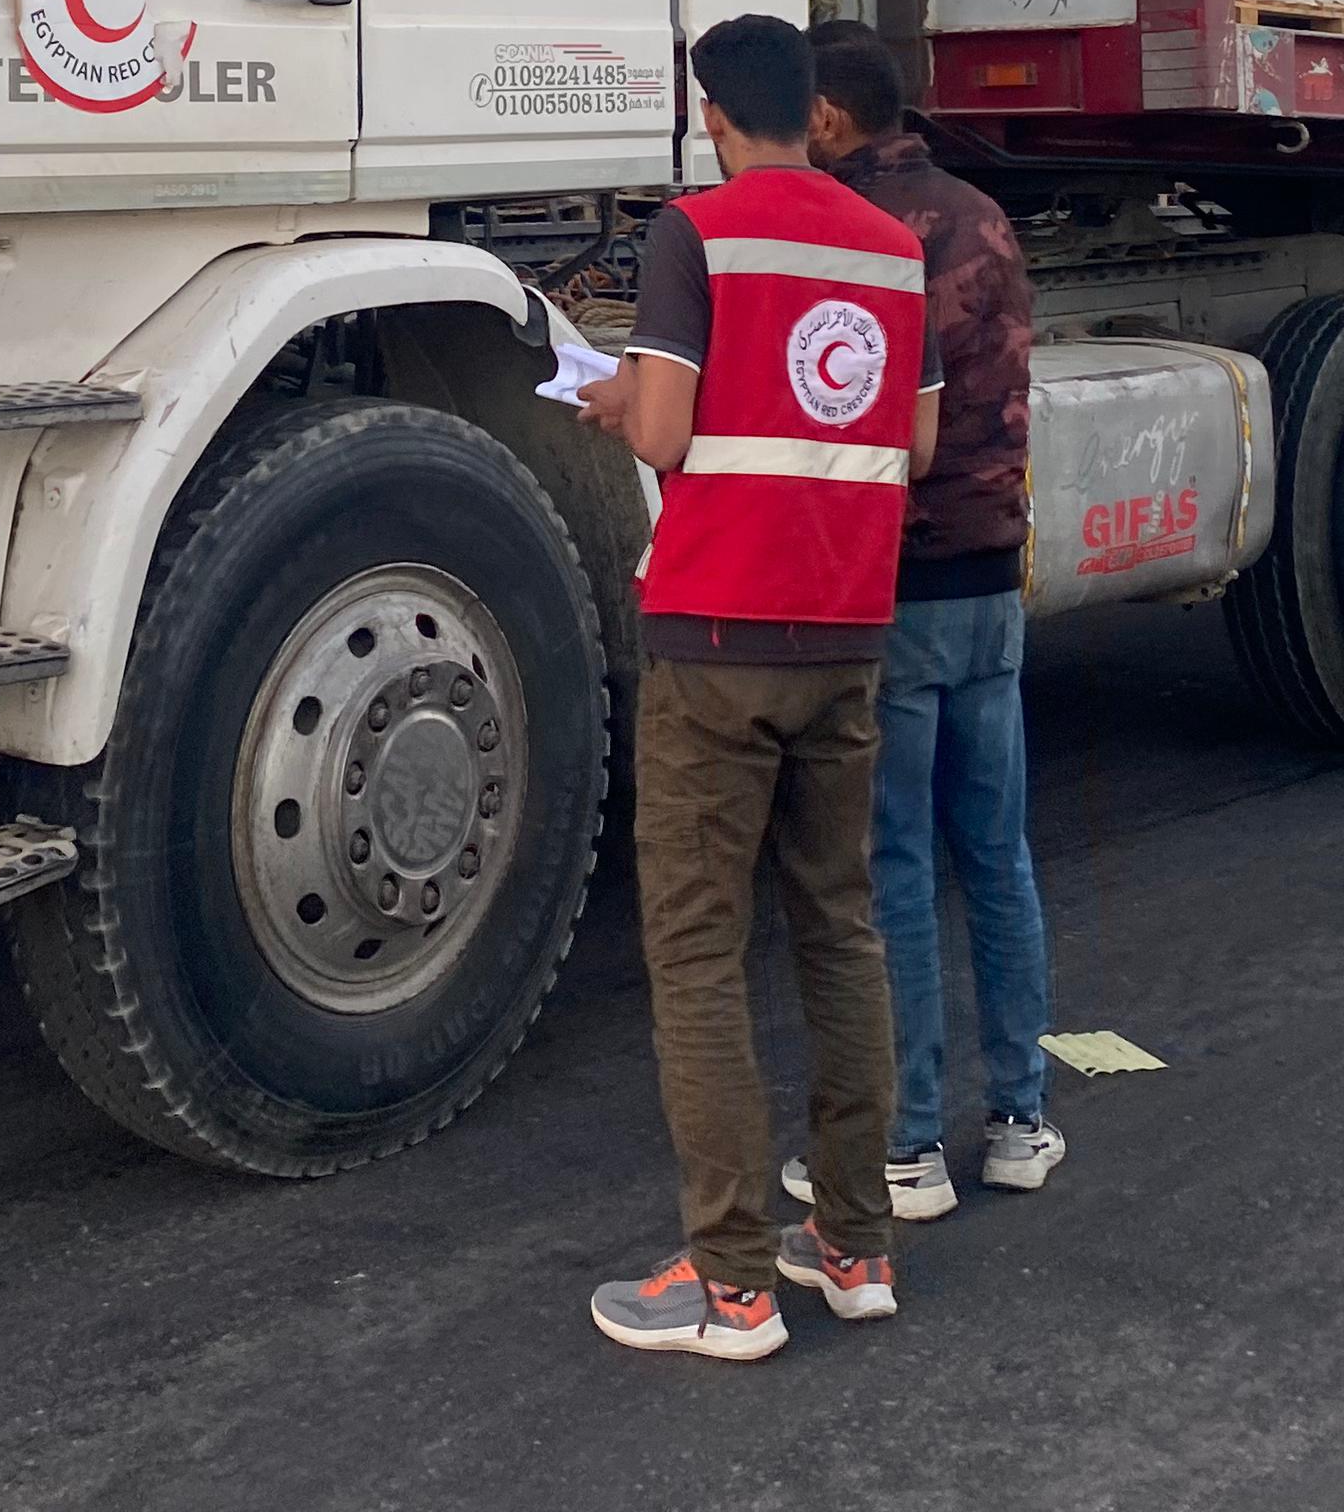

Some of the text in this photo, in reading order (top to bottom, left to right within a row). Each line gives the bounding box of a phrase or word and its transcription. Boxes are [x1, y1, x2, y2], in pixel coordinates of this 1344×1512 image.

[30, 8, 103, 84] EGYPTIAN
[108, 59, 141, 84] RED
[494, 43, 556, 63] SCANIA
[494, 64, 627, 87] 01092241485
[496, 93, 628, 115] 01005508153
[795, 359, 875, 418] EGYPTIAN RED CRESCENT
[1082, 489, 1199, 549] GIFAS
